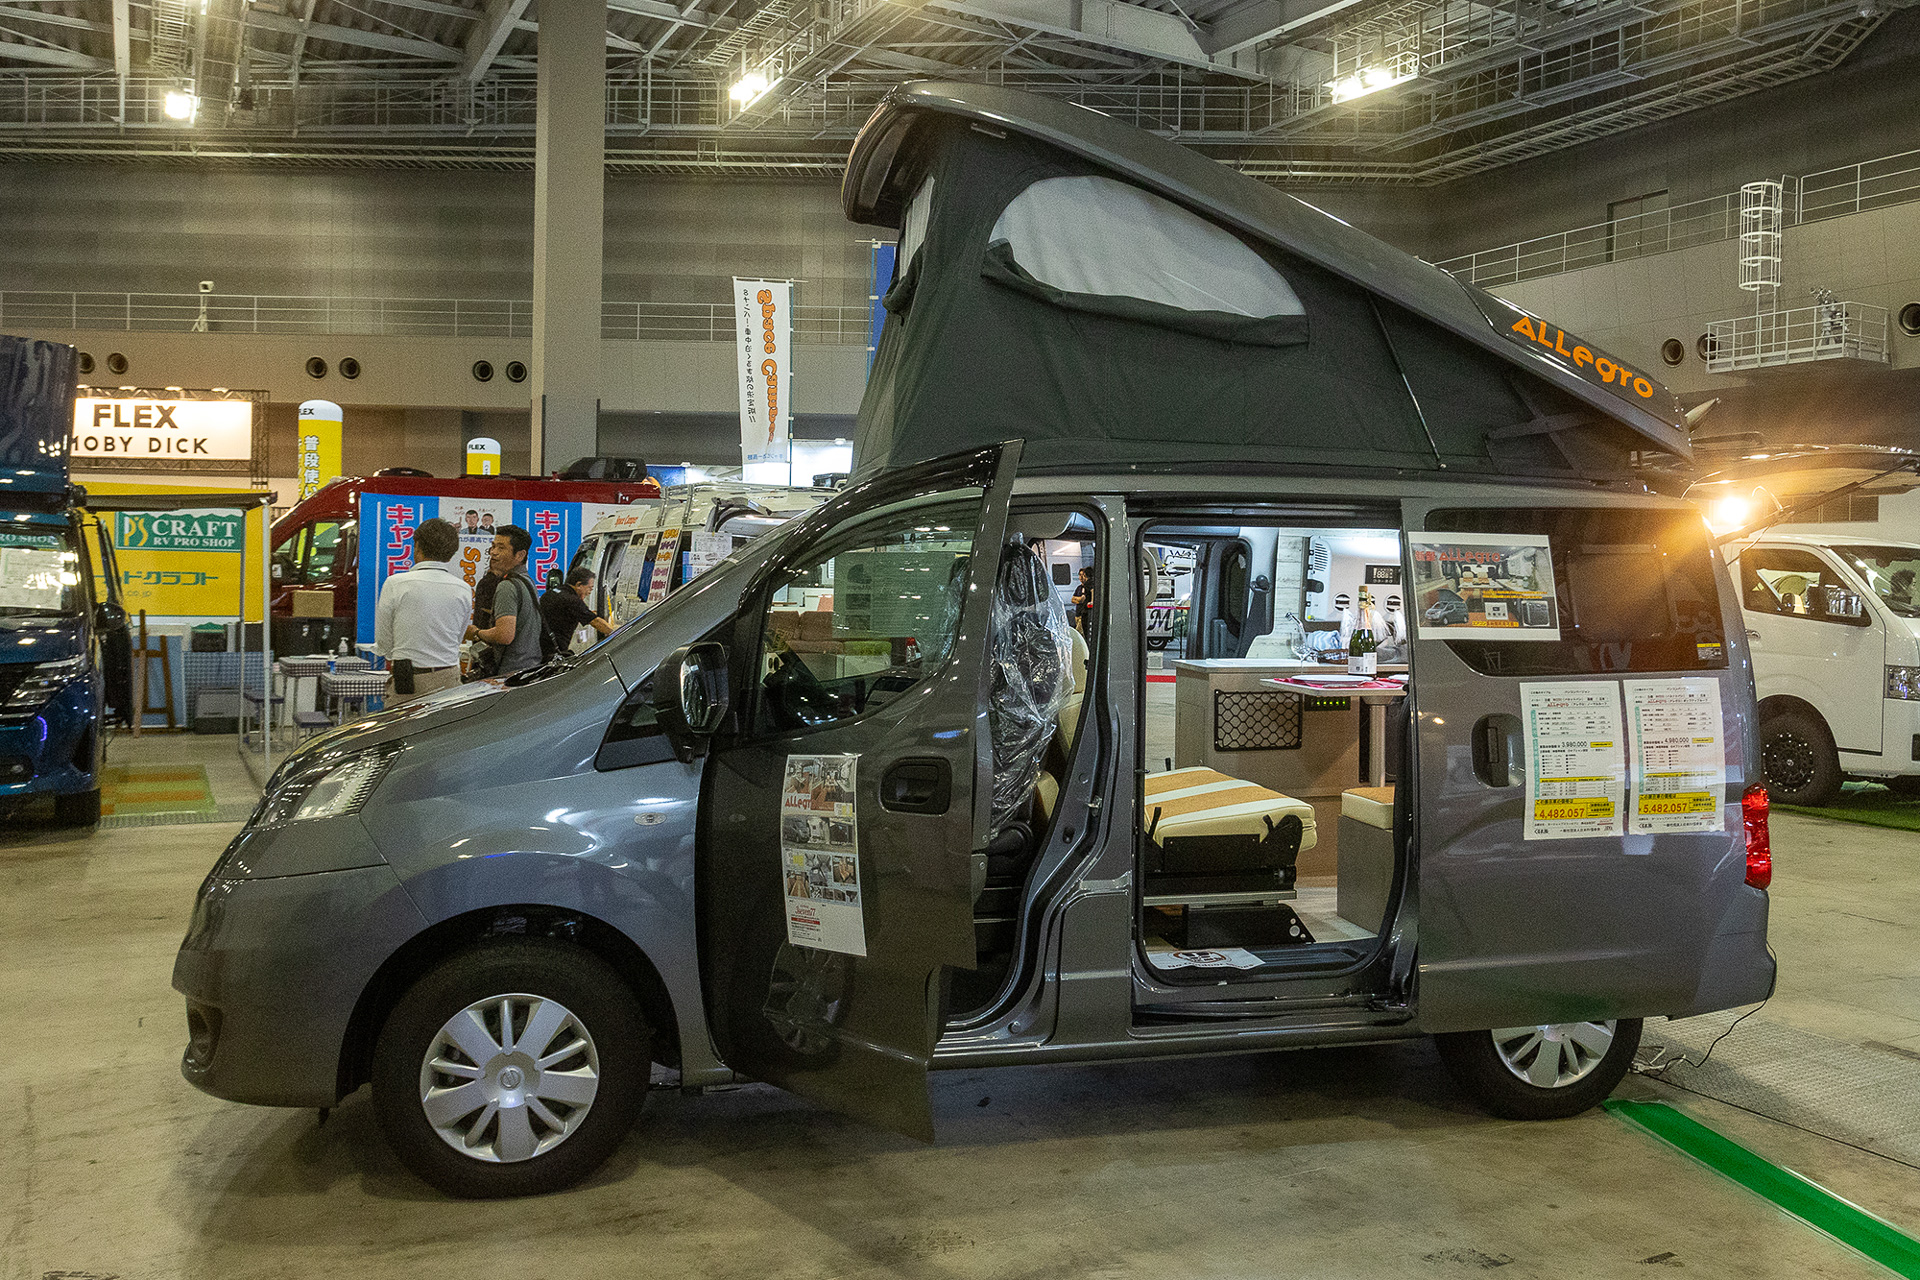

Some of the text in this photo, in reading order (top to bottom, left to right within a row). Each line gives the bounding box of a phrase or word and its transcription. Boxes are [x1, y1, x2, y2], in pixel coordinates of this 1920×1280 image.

[93, 404, 179, 429] FLEX
[148, 437, 209, 454] DICK
[151, 519, 238, 538] CRAFT
[153, 537, 236, 548] RV PRO SHOP
